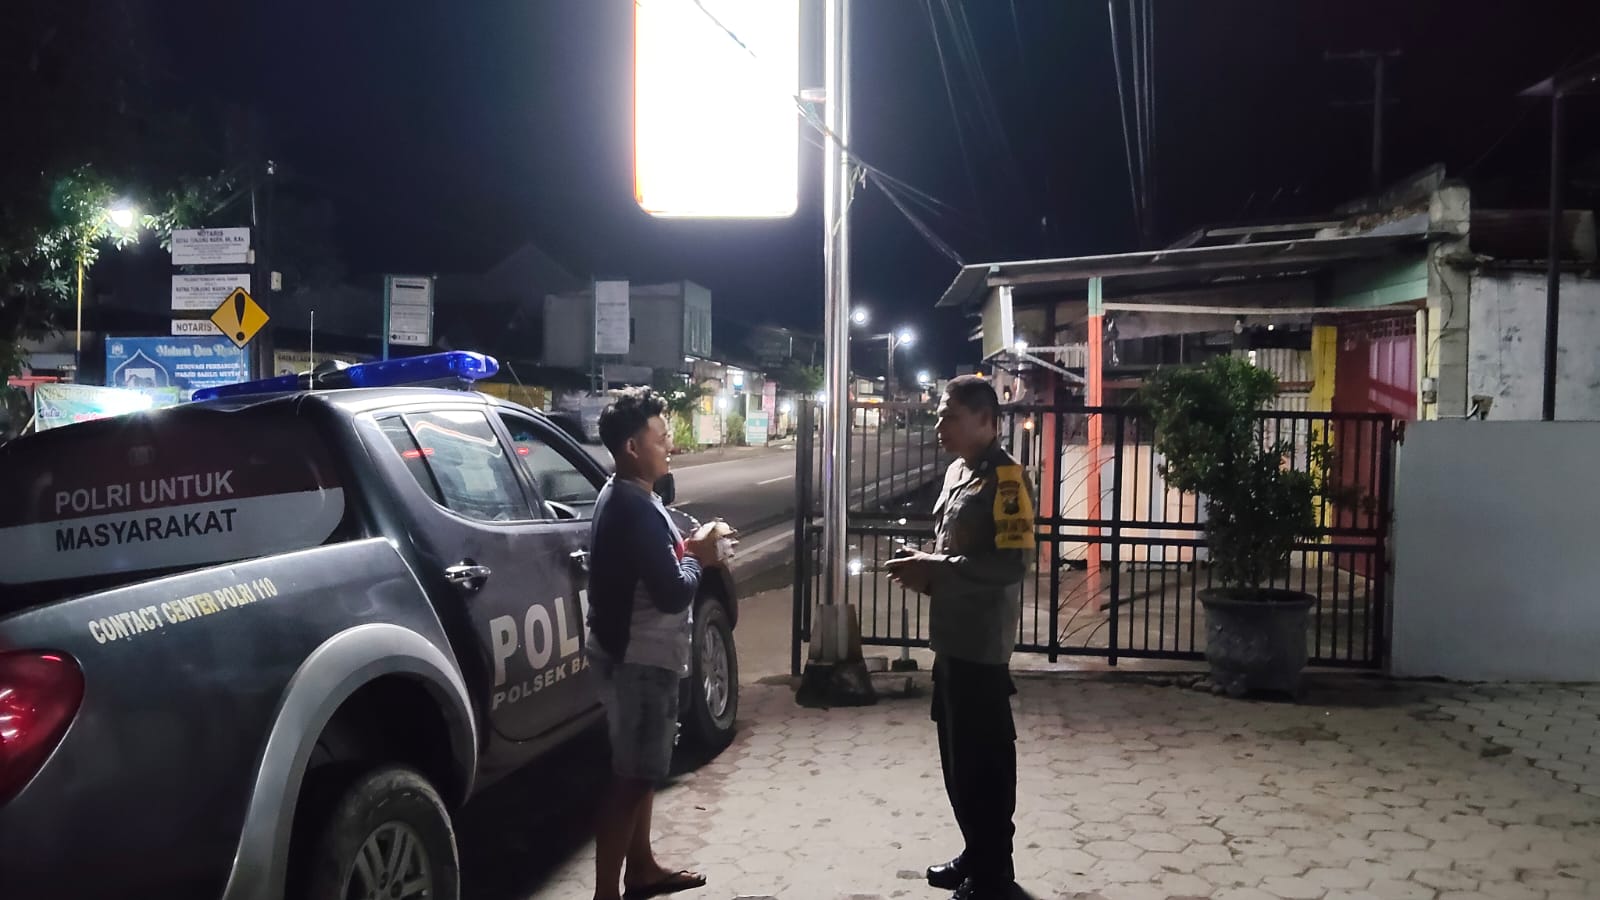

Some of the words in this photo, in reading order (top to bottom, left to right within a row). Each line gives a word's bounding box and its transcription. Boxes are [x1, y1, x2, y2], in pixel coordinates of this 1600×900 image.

[175, 322, 213, 332] NOTARIS
[55, 483, 130, 514] POLRI
[140, 470, 234, 504] UNTUK
[56, 508, 237, 551] MASYARAKAT
[88, 605, 163, 645] CONTACT
[161, 592, 220, 624] CENTER
[216, 582, 257, 610] POLRI
[253, 577, 278, 600] 110
[492, 664, 566, 710] POLSEK
